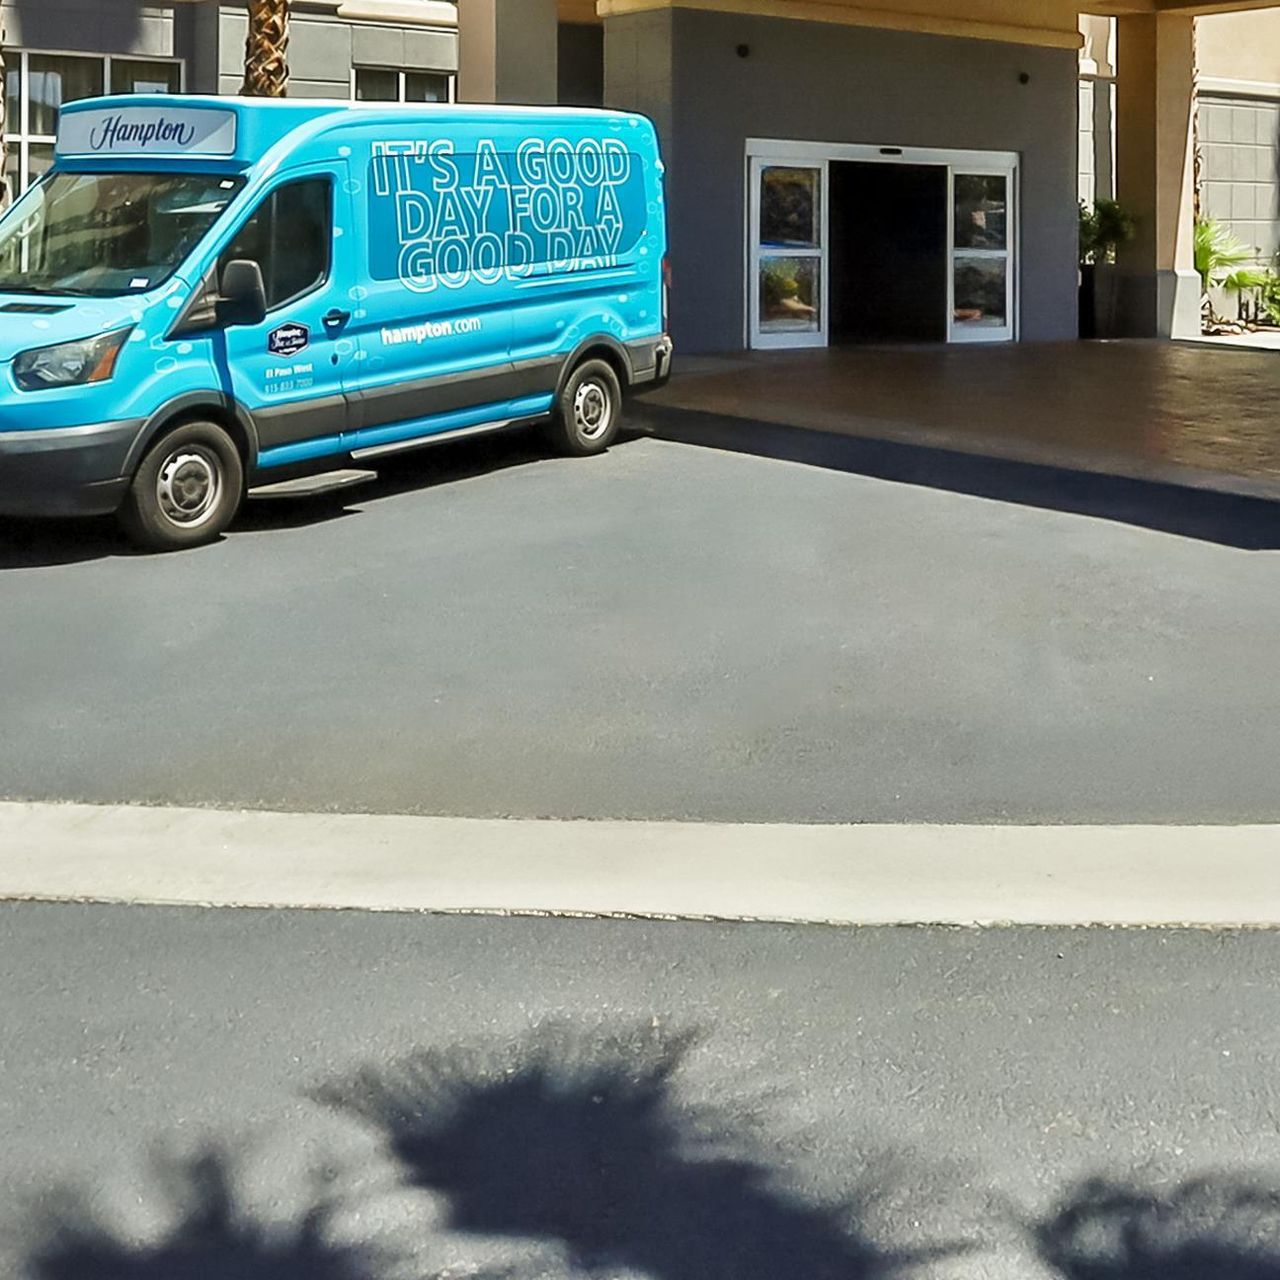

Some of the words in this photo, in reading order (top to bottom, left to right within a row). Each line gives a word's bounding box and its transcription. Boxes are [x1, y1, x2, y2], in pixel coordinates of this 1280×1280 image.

[90, 114, 195, 151] Hampton
[371, 138, 460, 197] IT'S
[473, 138, 510, 190] A
[516, 137, 631, 189] GOOD
[395, 185, 494, 245] DAY
[506, 183, 586, 236] FOR
[595, 181, 624, 228] A
[398, 231, 535, 293] GOOD
[547, 223, 624, 273] DAY
[380, 317, 482, 345] hampton.com
